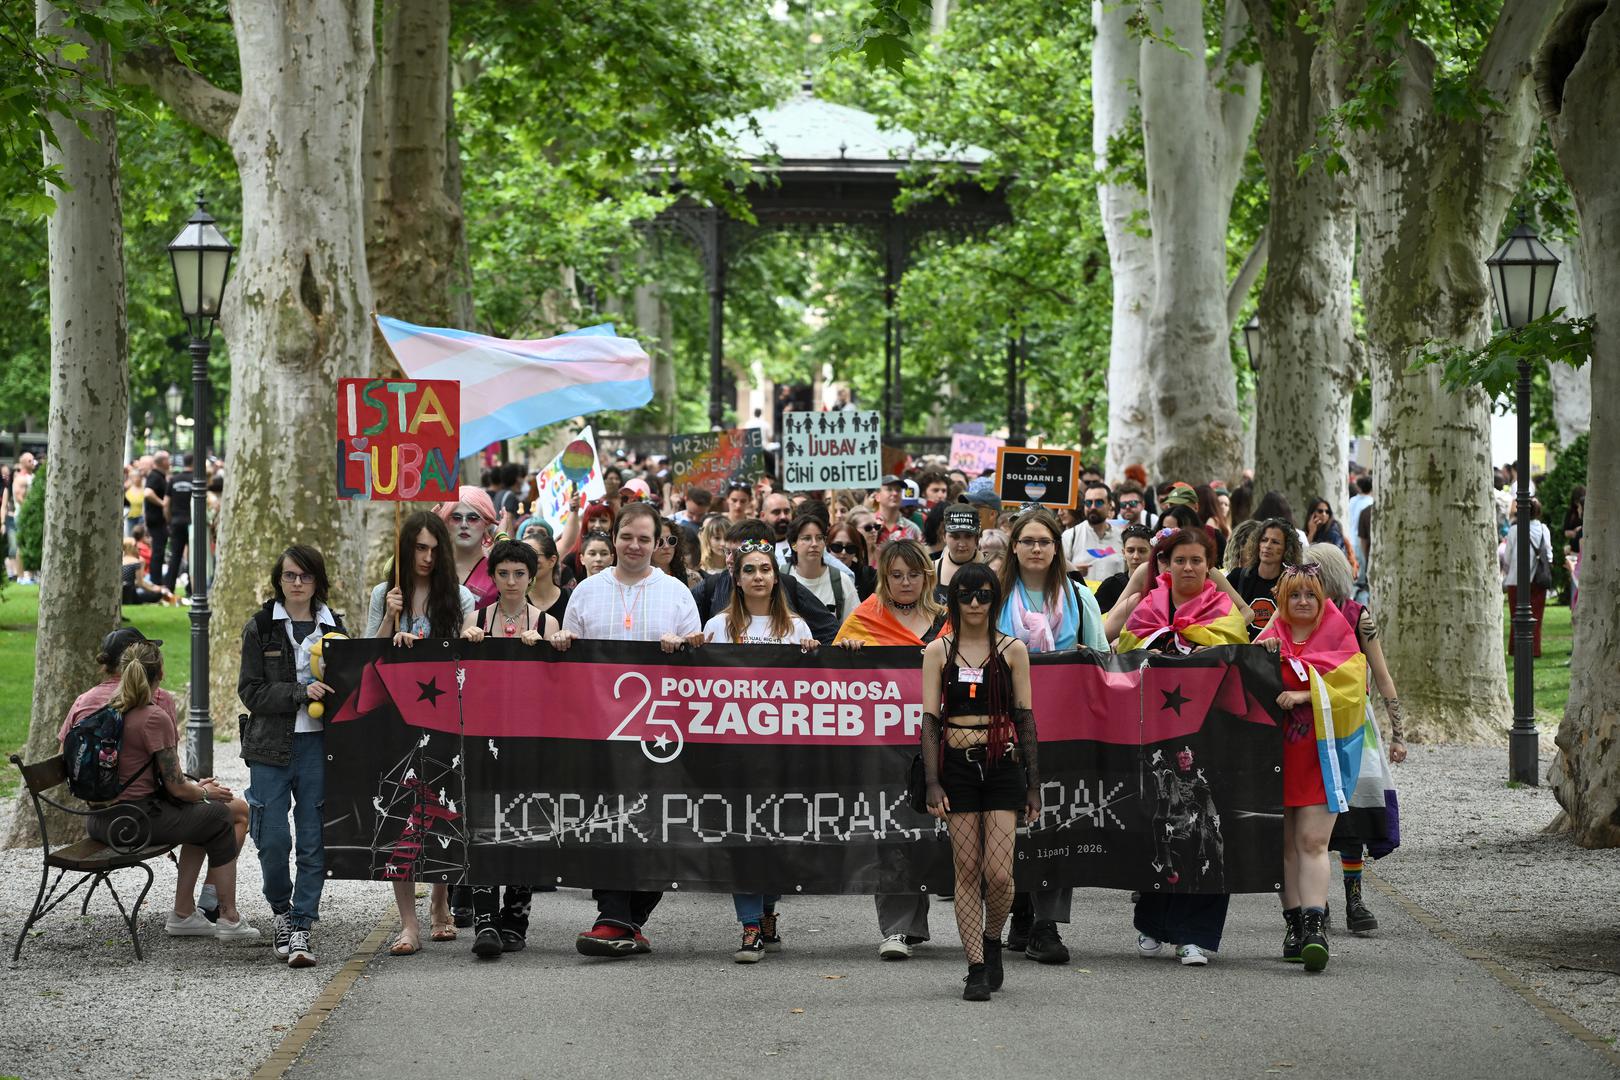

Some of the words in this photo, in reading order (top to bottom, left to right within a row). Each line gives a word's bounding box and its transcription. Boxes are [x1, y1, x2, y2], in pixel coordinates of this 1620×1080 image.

[346, 379, 455, 437] ISTA
[1006, 473, 1054, 482] SOLIDARNI
[661, 677, 788, 699] POVORKA
[794, 680, 901, 700] PONOSA
[606, 671, 684, 763] 25
[688, 701, 864, 737] ZAGREB
[495, 793, 649, 843] KORAK
[663, 793, 733, 843] PO
[1037, 845, 1070, 859] lipanj
[1077, 844, 1107, 854] 2026.
